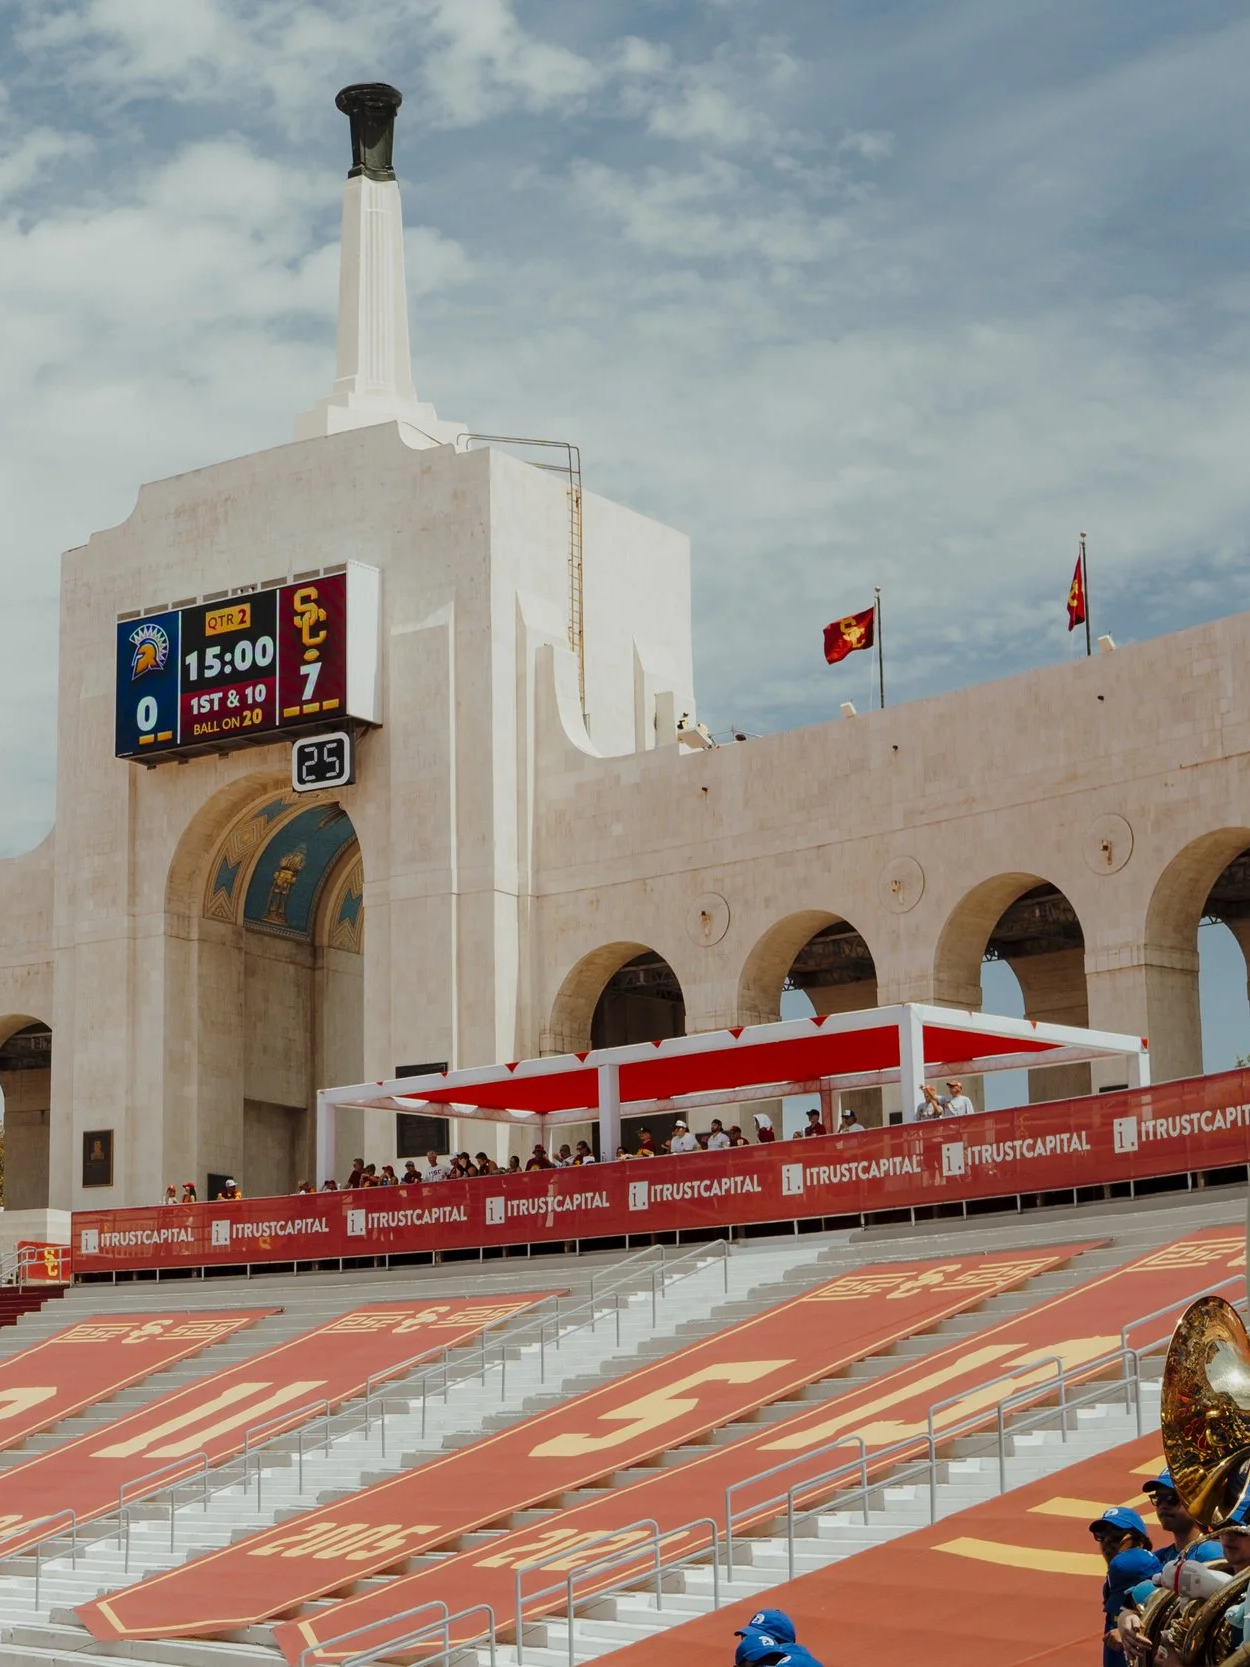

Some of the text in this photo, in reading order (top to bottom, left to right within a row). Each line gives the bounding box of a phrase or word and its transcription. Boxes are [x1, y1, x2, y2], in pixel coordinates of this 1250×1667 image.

[207, 608, 248, 631] QTR 2
[185, 635, 274, 681] 15:00
[300, 662, 322, 700] 7
[136, 696, 158, 732] 0
[190, 684, 267, 715] 1ST & 10
[193, 708, 262, 735] BALL ON 20
[302, 742, 340, 781] 25
[967, 1131, 1091, 1166] ITRUSTCAPITAL
[806, 1155, 921, 1185] ITRUSTCAPITAL
[508, 1191, 610, 1216] ITRUSTCAPITAL
[651, 1175, 762, 1202] ITRUSTCAPITAL
[232, 1218, 328, 1238] ITRUSTCAPITAL
[368, 1206, 467, 1228] ITRUSTCAPITAL
[101, 1227, 194, 1247] ITRUSTCAPITAL
[88, 1381, 329, 1458] 11
[528, 1359, 795, 1457] 5
[248, 1522, 441, 1560] 2005
